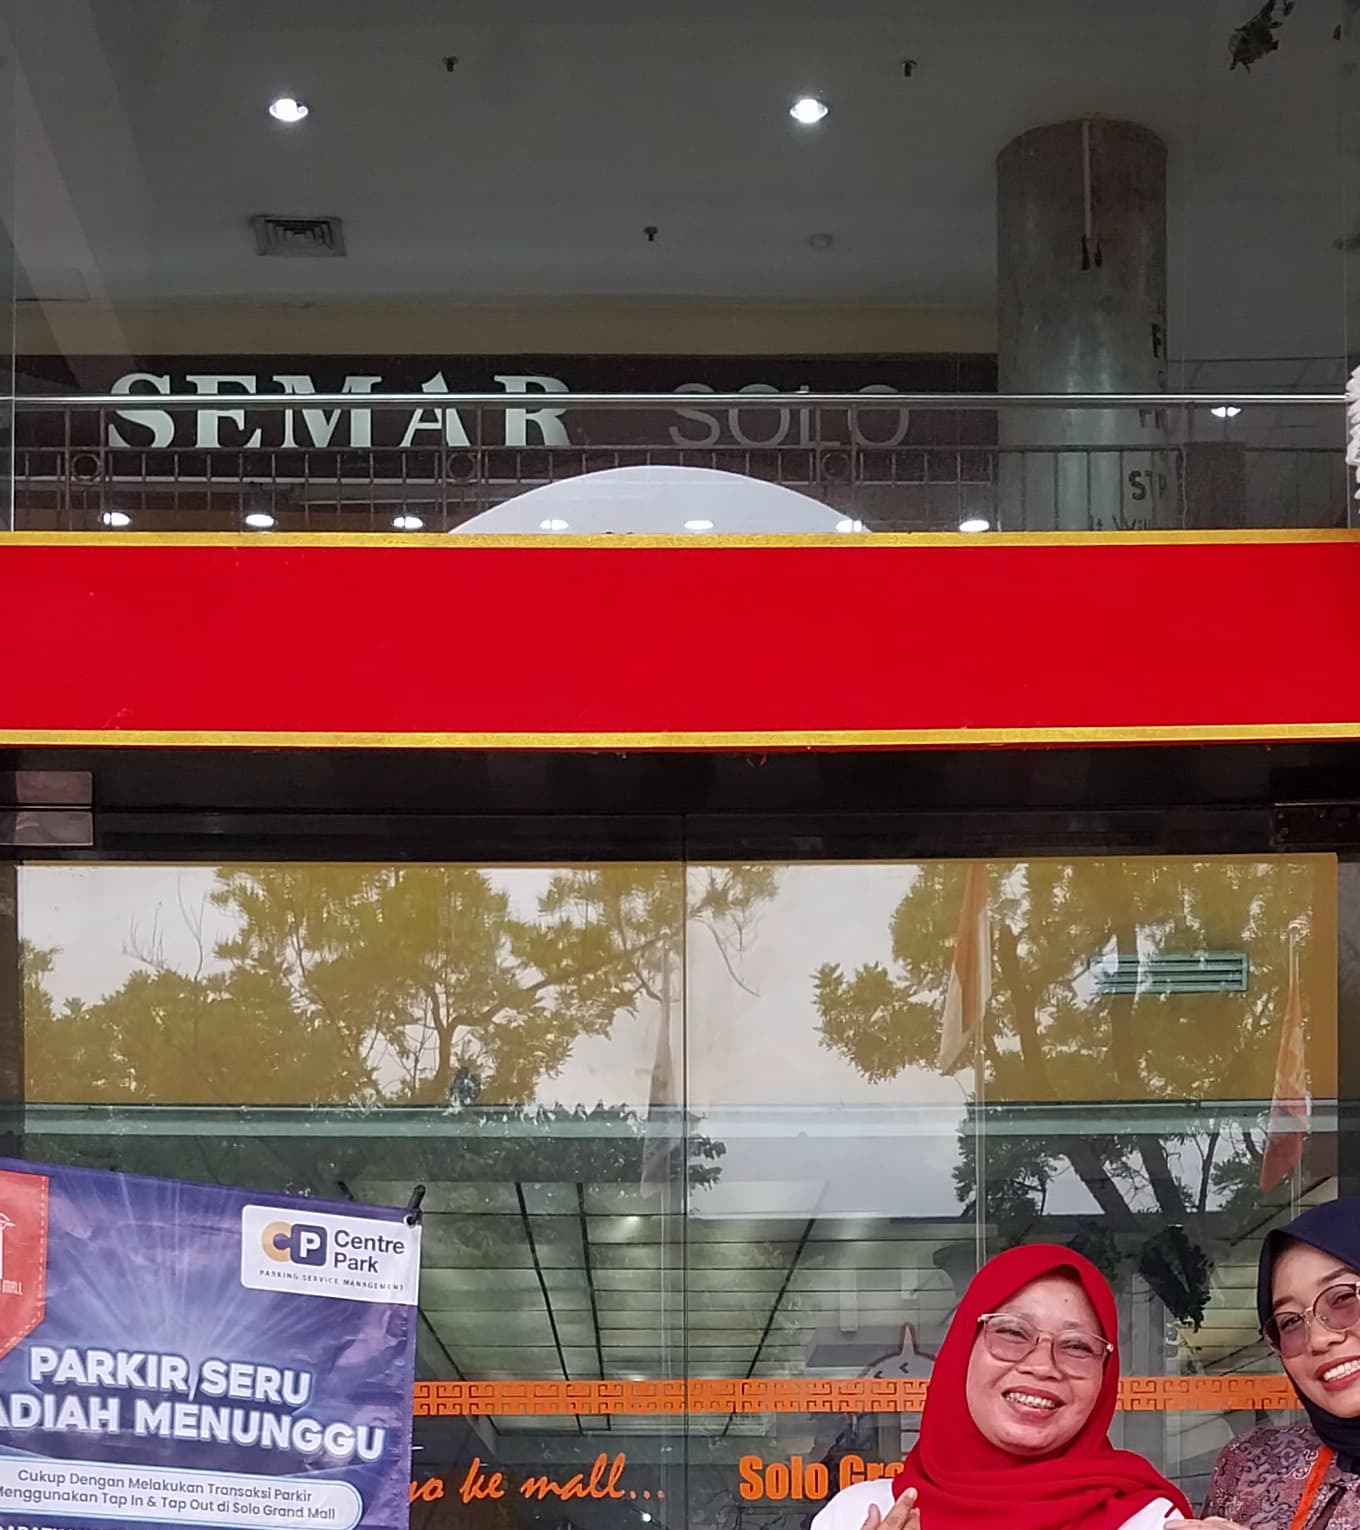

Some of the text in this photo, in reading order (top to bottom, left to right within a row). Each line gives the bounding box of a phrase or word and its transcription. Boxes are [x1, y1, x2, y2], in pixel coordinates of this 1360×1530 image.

[109, 371, 910, 448] SEMAR SOLO
[334, 1230, 405, 1254] Centre
[334, 1252, 378, 1273] Park
[30, 1346, 311, 1407] PARKIR SERU
[135, 1398, 385, 1462] MENUNGGU
[18, 1470, 312, 1502] Cukup Dengan Melakukan Transaksi Parkir
[459, 1457, 505, 1504] ke
[739, 1455, 829, 1500] Solo
[101, 1492, 128, 1508] Tap
[131, 1495, 144, 1506] In
[147, 1496, 157, 1507] &
[161, 1497, 186, 1512] Tap
[190, 1499, 214, 1512] Out
[217, 1501, 229, 1512] di
[233, 1502, 260, 1515] Solo
[263, 1505, 304, 1518] Grand
[308, 1507, 335, 1520] Mall
